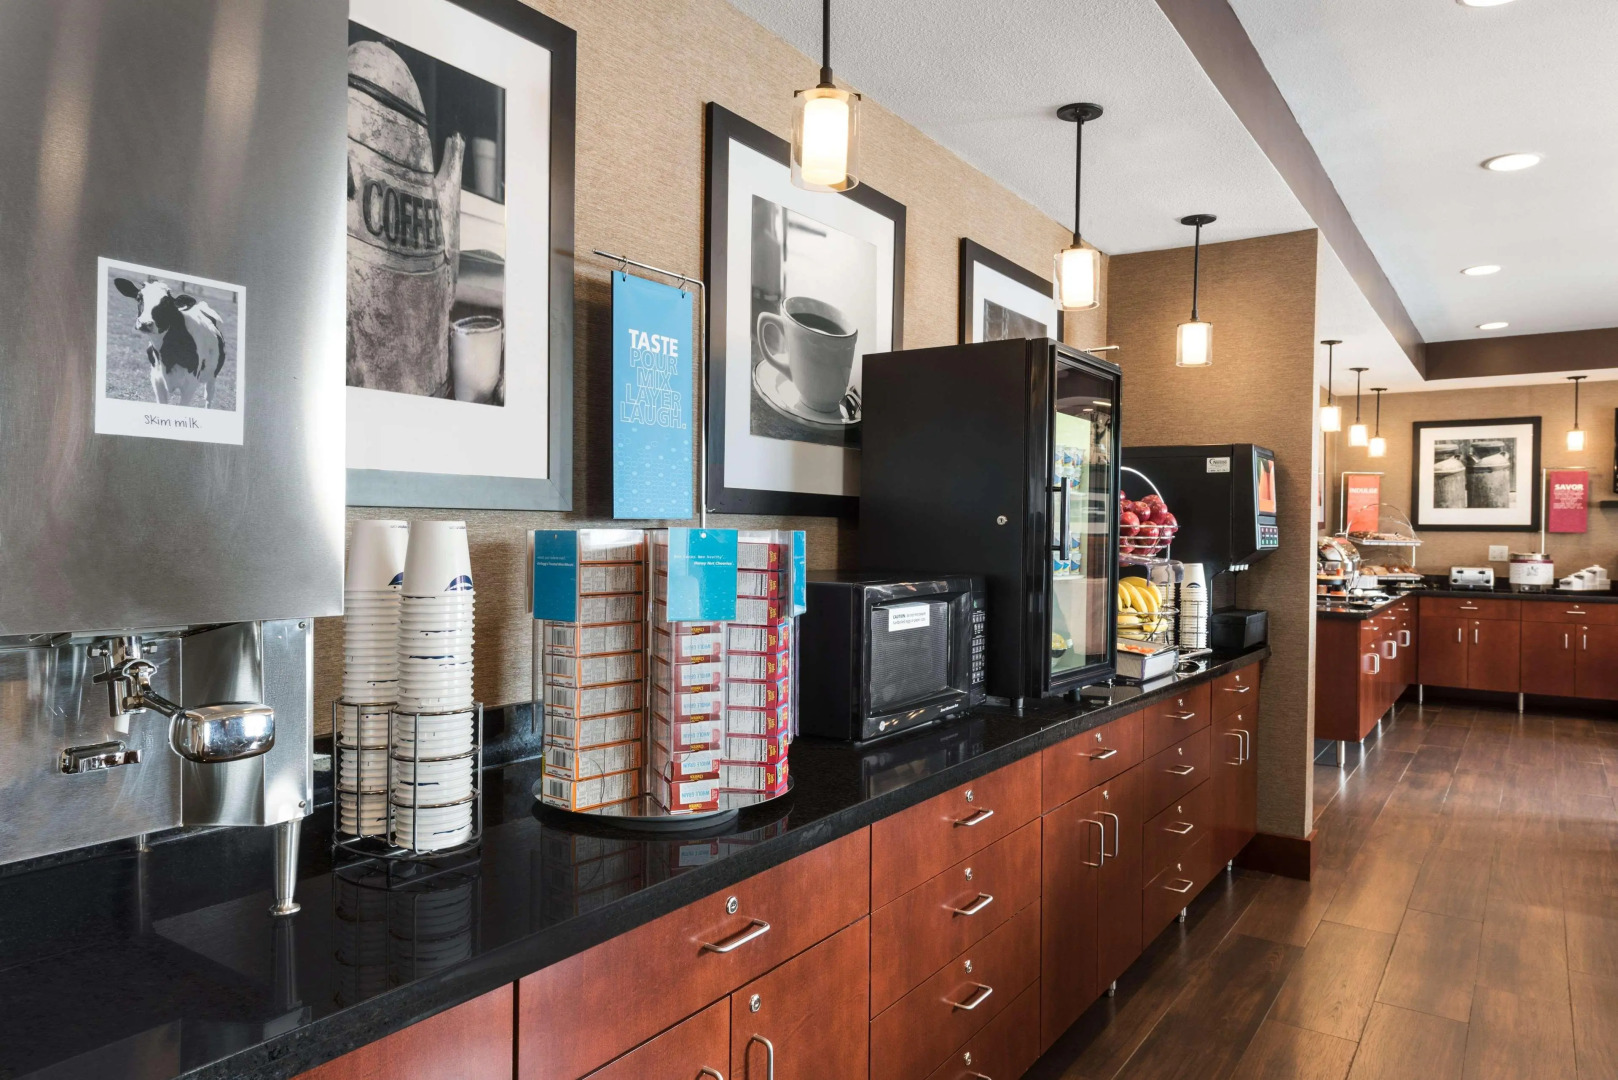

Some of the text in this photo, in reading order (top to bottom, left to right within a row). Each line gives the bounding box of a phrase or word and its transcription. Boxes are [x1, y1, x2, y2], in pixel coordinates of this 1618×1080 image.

[628, 329, 678, 357] TASTE
[630, 348, 678, 375] POUR
[636, 367, 672, 391] MIX
[625, 384, 681, 410] LAYER
[620, 401, 686, 429] LAUGH.
